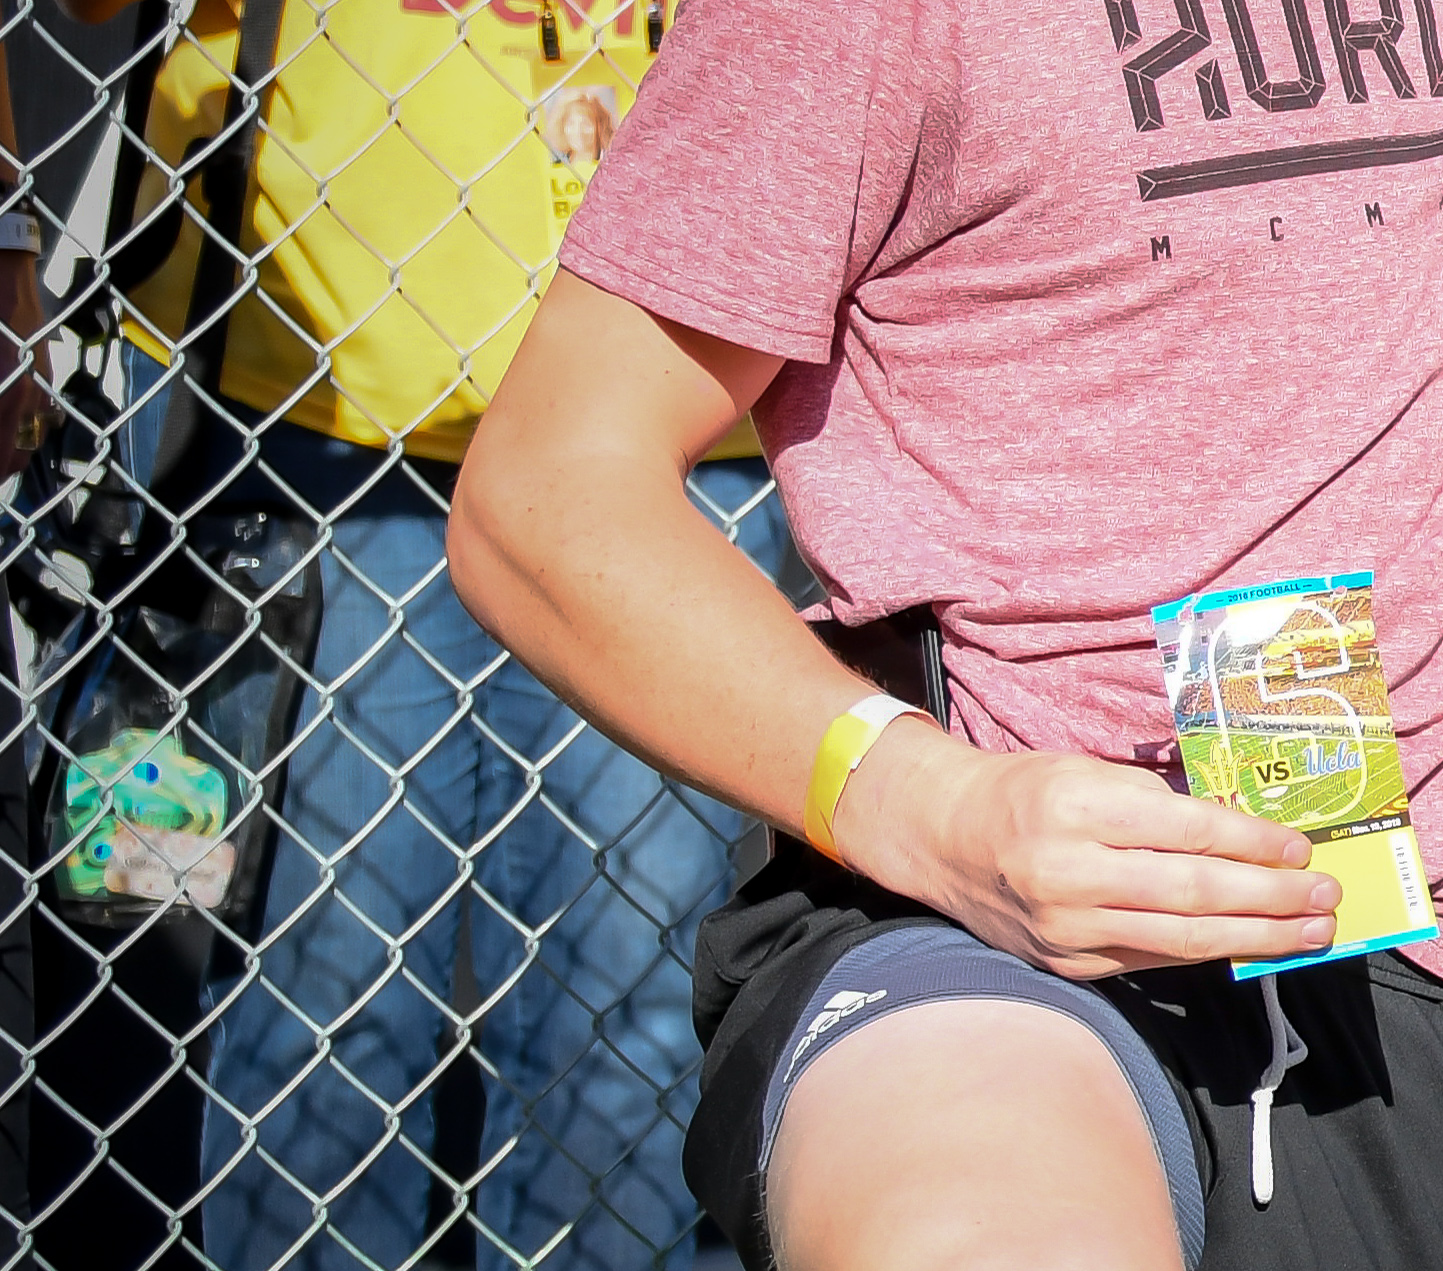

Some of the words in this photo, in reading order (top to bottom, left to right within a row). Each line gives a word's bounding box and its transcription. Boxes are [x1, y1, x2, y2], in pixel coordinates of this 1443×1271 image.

[1250, 583, 1301, 598] FOOTBALL
[1257, 758, 1291, 784] VS
[1303, 740, 1362, 777] Ucla
